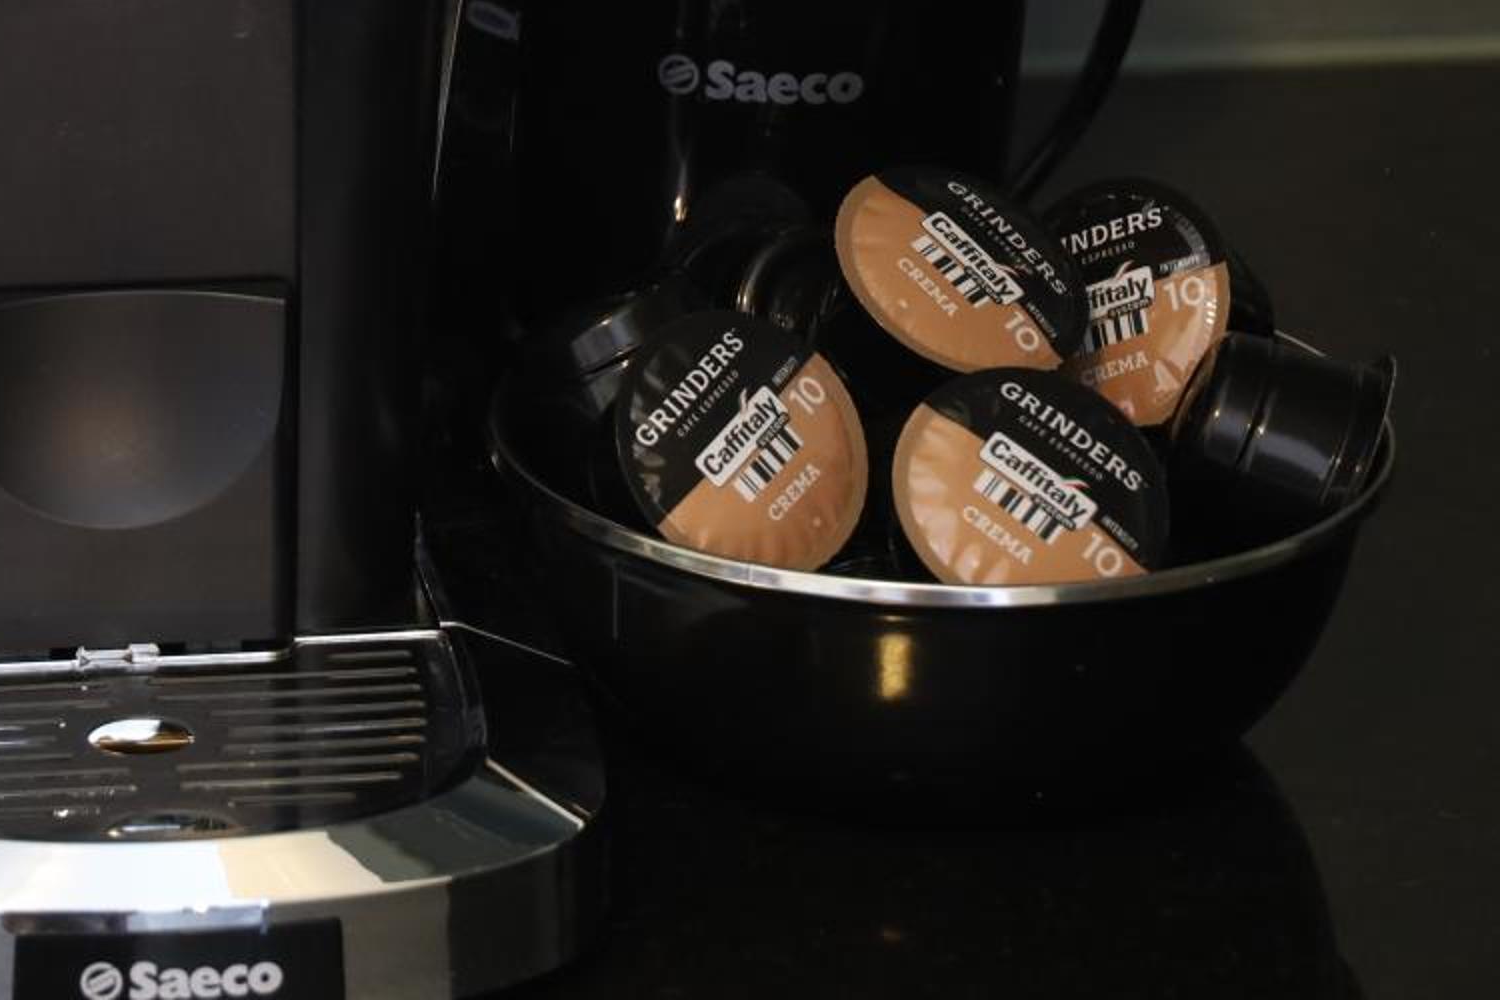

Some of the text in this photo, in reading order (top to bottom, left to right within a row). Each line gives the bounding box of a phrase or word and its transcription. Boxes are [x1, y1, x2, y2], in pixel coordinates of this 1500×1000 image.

[705, 60, 863, 105] Saeco
[931, 214, 1018, 300] Caffitaly
[947, 181, 1067, 295] GRINDERS
[1061, 208, 1163, 254] NDERS
[897, 257, 959, 317] CREMA
[1163, 275, 1206, 312] 10
[1005, 311, 1040, 351] 10
[636, 330, 744, 447] GRINDERS
[789, 375, 826, 416] 10
[703, 395, 785, 476] Caffitaly
[1000, 381, 1142, 492] GRINDERS
[768, 463, 821, 521] CREMA
[989, 438, 1087, 520] Caffitaly
[963, 506, 1034, 565] CREMA
[1082, 532, 1123, 577] 10
[129, 961, 283, 1000] Saeco
